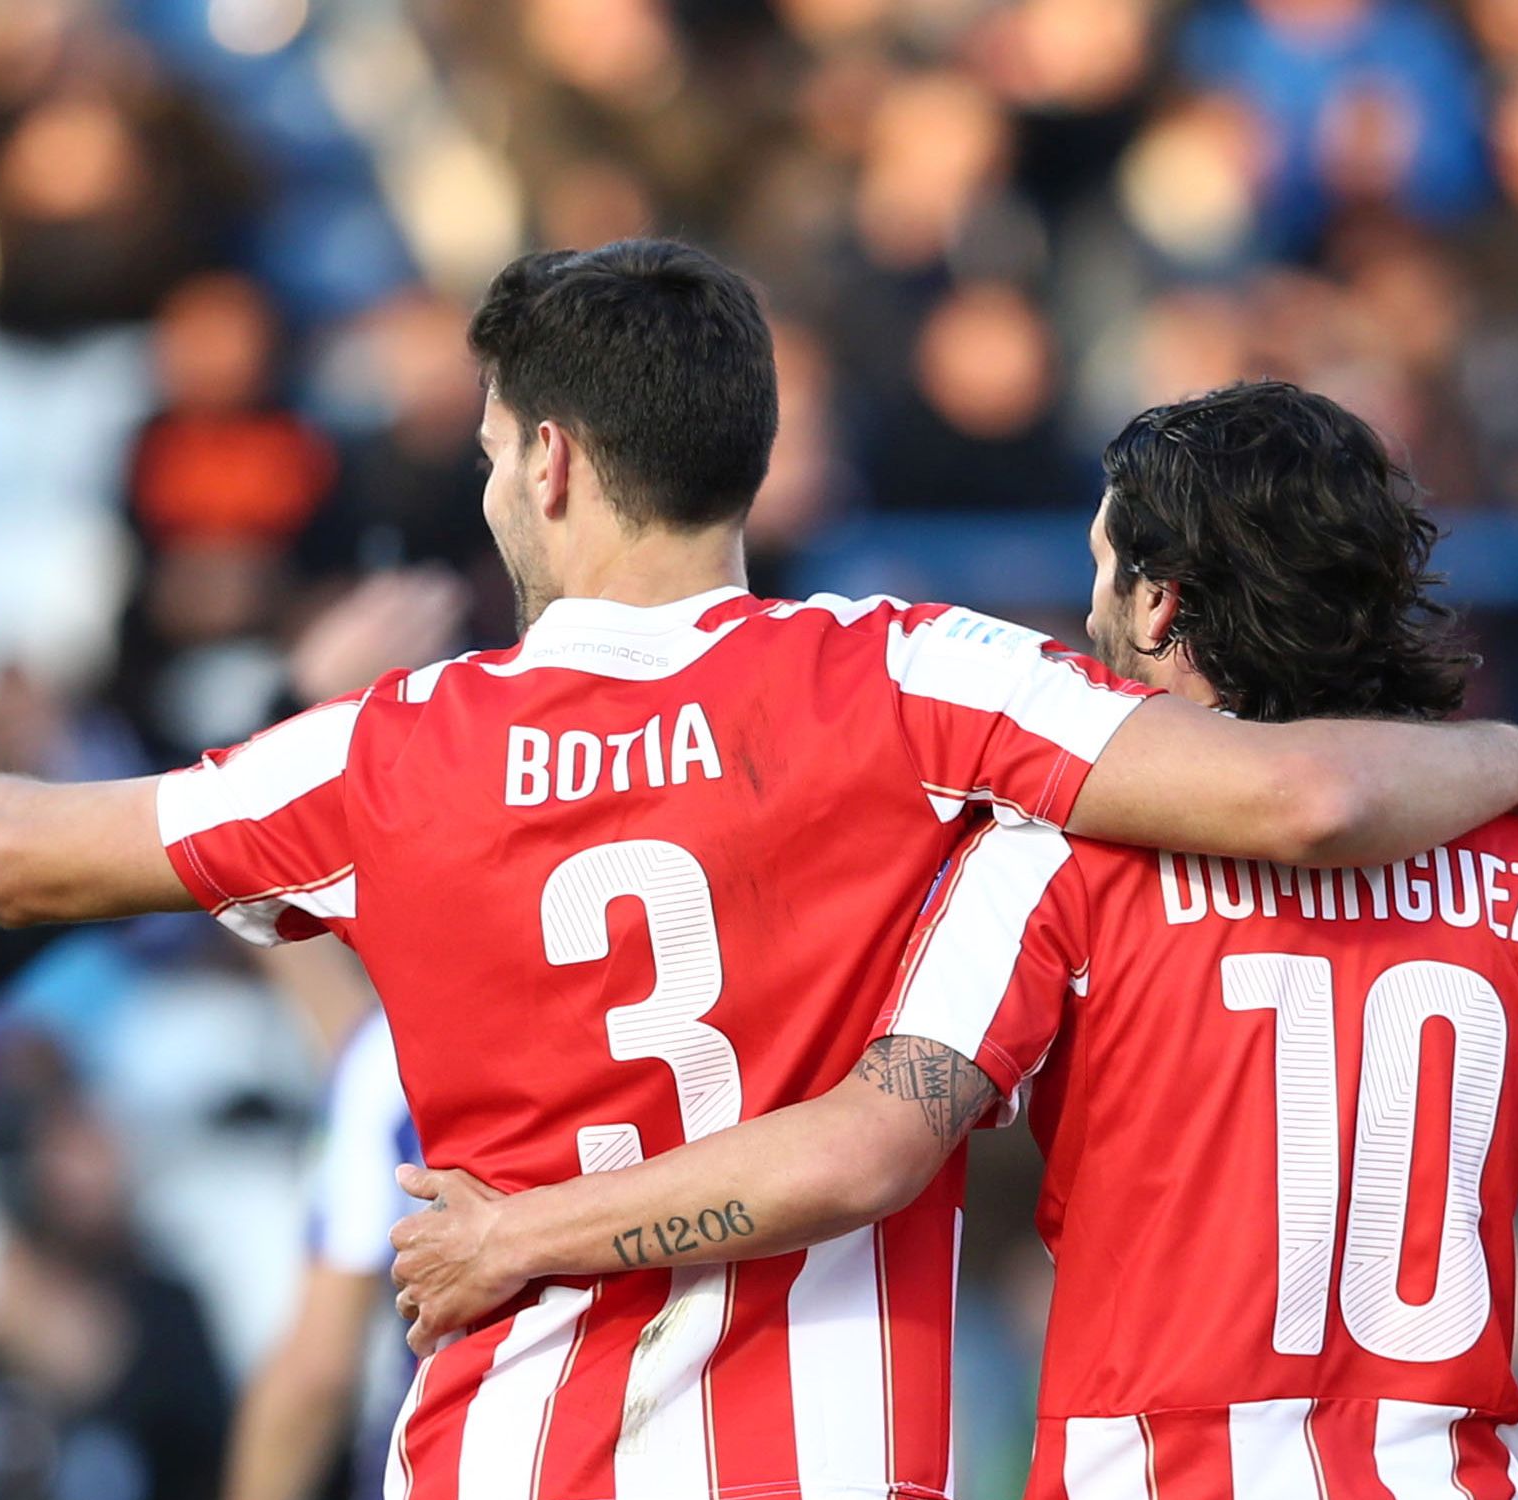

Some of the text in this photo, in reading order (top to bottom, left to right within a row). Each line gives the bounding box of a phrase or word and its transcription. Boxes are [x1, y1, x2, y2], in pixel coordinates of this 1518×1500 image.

[504, 702, 723, 806] BOTIA
[540, 839, 742, 1175] 3
[1220, 952, 1506, 1363] 10
